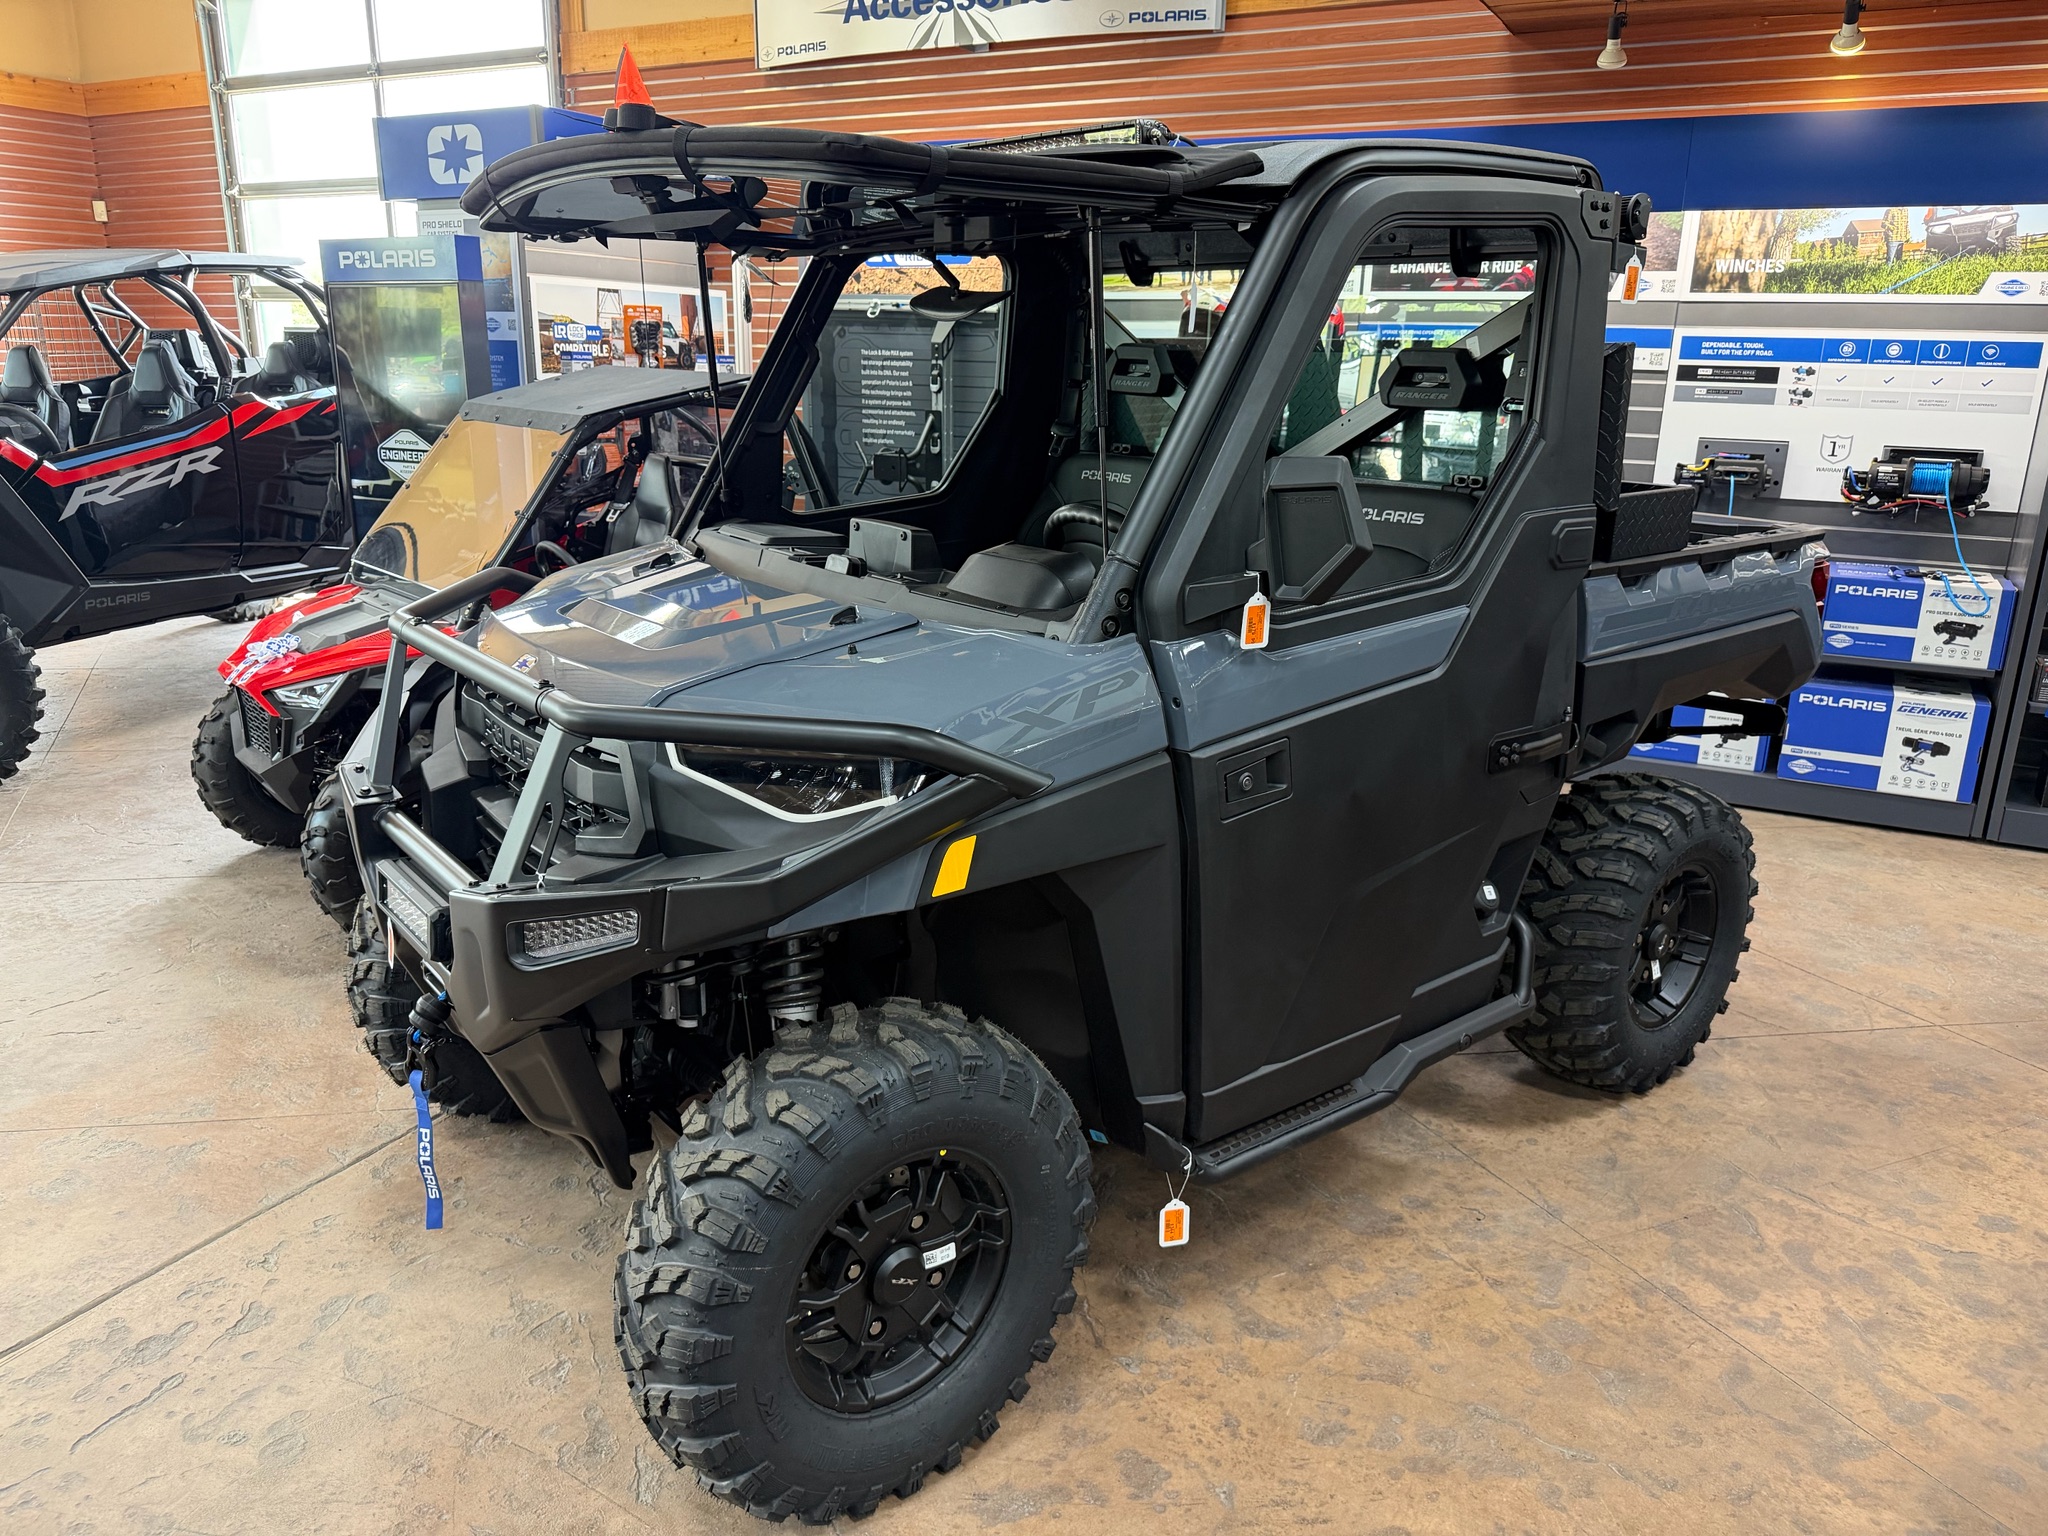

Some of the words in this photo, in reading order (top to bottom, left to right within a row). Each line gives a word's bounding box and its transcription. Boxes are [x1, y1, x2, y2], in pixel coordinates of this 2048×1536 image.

[1129, 8, 1207, 24] POLARIS
[777, 40, 827, 57] POLARIS
[422, 221, 436, 229] PRO
[437, 220, 462, 229] SHIELD
[338, 249, 437, 269] POLARIS
[1491, 260, 1522, 273] RIDE
[1715, 259, 1785, 274] WINCHES
[1390, 262, 1450, 274] ENHANCE
[554, 325, 567, 339] LR
[553, 342, 610, 357] COMPATIBLE
[1702, 341, 1742, 349] DEPENDABLE.
[1114, 379, 1150, 388] RANGER
[1394, 391, 1449, 400] RANGER
[381, 449, 427, 462] ENGINEER
[1827, 441, 1838, 457] 1
[58, 446, 224, 523] RZR
[1081, 470, 1132, 484] POLARIS
[1361, 507, 1426, 525] OLARIS
[85, 591, 151, 609] POLARIS
[1835, 584, 1919, 600] POLARIS
[996, 668, 1141, 751] XP
[1798, 693, 1887, 712] POLARIS
[1896, 704, 1968, 720] GENERAL
[420, 1127, 440, 1199] POLARIS
